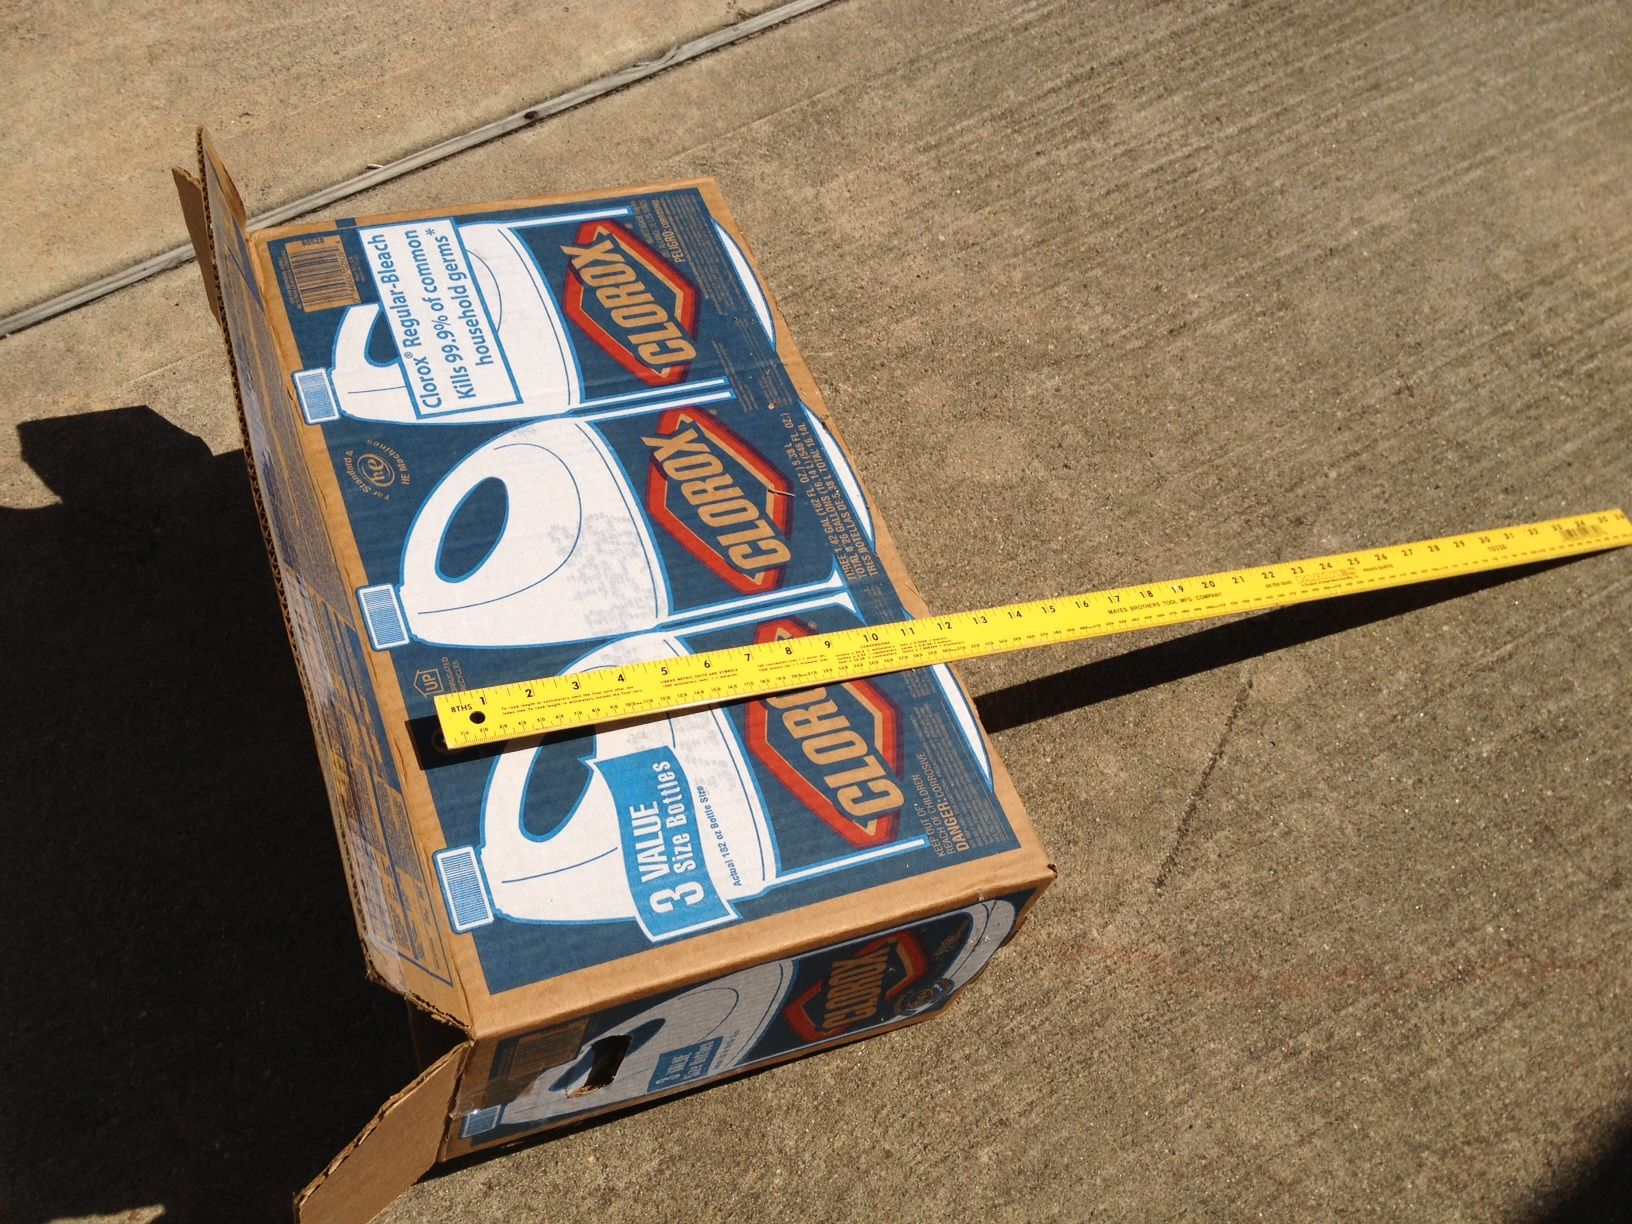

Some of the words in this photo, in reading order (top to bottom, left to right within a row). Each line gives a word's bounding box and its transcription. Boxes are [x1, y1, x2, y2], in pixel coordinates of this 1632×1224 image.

[405, 230, 437, 293] common
[369, 234, 420, 347] Regular-Bleach
[421, 297, 444, 311] of
[559, 239, 695, 364] CLOROX
[432, 315, 463, 363] 99.9%
[448, 285, 492, 365] household
[450, 365, 475, 399] Kills
[400, 474, 410, 485] HE
[639, 427, 790, 569] CLOROX
[820, 495, 845, 532] GALLONS
[840, 511, 868, 553] BOTELLAS
[861, 554, 878, 576] TRES
[1129, 601, 1160, 611] BROTHERS
[1195, 591, 1222, 600] COMPANY
[479, 696, 485, 705] 1
[525, 688, 533, 697] 2
[572, 681, 579, 689] 3
[617, 673, 624, 681] 4
[660, 666, 667, 675] 5
[703, 659, 710, 668] 6
[744, 653, 750, 661] 7
[785, 646, 791, 654] 8
[824, 640, 831, 648] 9
[863, 632, 878, 642] 10
[900, 627, 914, 636] 11
[937, 621, 951, 630] 12
[972, 615, 987, 624] 13
[1007, 610, 1022, 619] 14
[1041, 605, 1055, 613] 15
[1075, 600, 1088, 608] 16
[1107, 595, 1120, 603] 17
[1140, 589, 1153, 598] 18
[1171, 585, 1184, 593] 19
[1201, 580, 1215, 588] 20
[1232, 575, 1244, 584] 21
[1261, 570, 1275, 579] 22
[1290, 566, 1303, 574] 23
[1319, 561, 1332, 570] 24
[1346, 557, 1360, 565] 25
[1374, 552, 1387, 561] 26
[1401, 548, 1412, 556] 27
[1427, 544, 1439, 552] 28
[421, 673, 438, 691] UP
[450, 703, 472, 712] 8THS
[916, 752, 944, 797] CORROSIVE
[653, 761, 686, 827] Bottles
[696, 785, 708, 803] Size
[911, 774, 936, 813] CHILDREN
[704, 804, 719, 829] Bottle
[914, 806, 926, 817] OF
[920, 818, 935, 835] OUT
[930, 815, 942, 826] OF
[937, 798, 969, 851] DANGER:
[630, 802, 668, 881] VALUE
[714, 830, 723, 840] oz
[717, 842, 729, 857] 182
[929, 836, 945, 857] KEEP
[936, 826, 955, 854] REACH
[672, 833, 695, 873] Size
[725, 859, 741, 886] Actual
[649, 881, 704, 912] 3
[822, 937, 898, 1029] CLOROX
